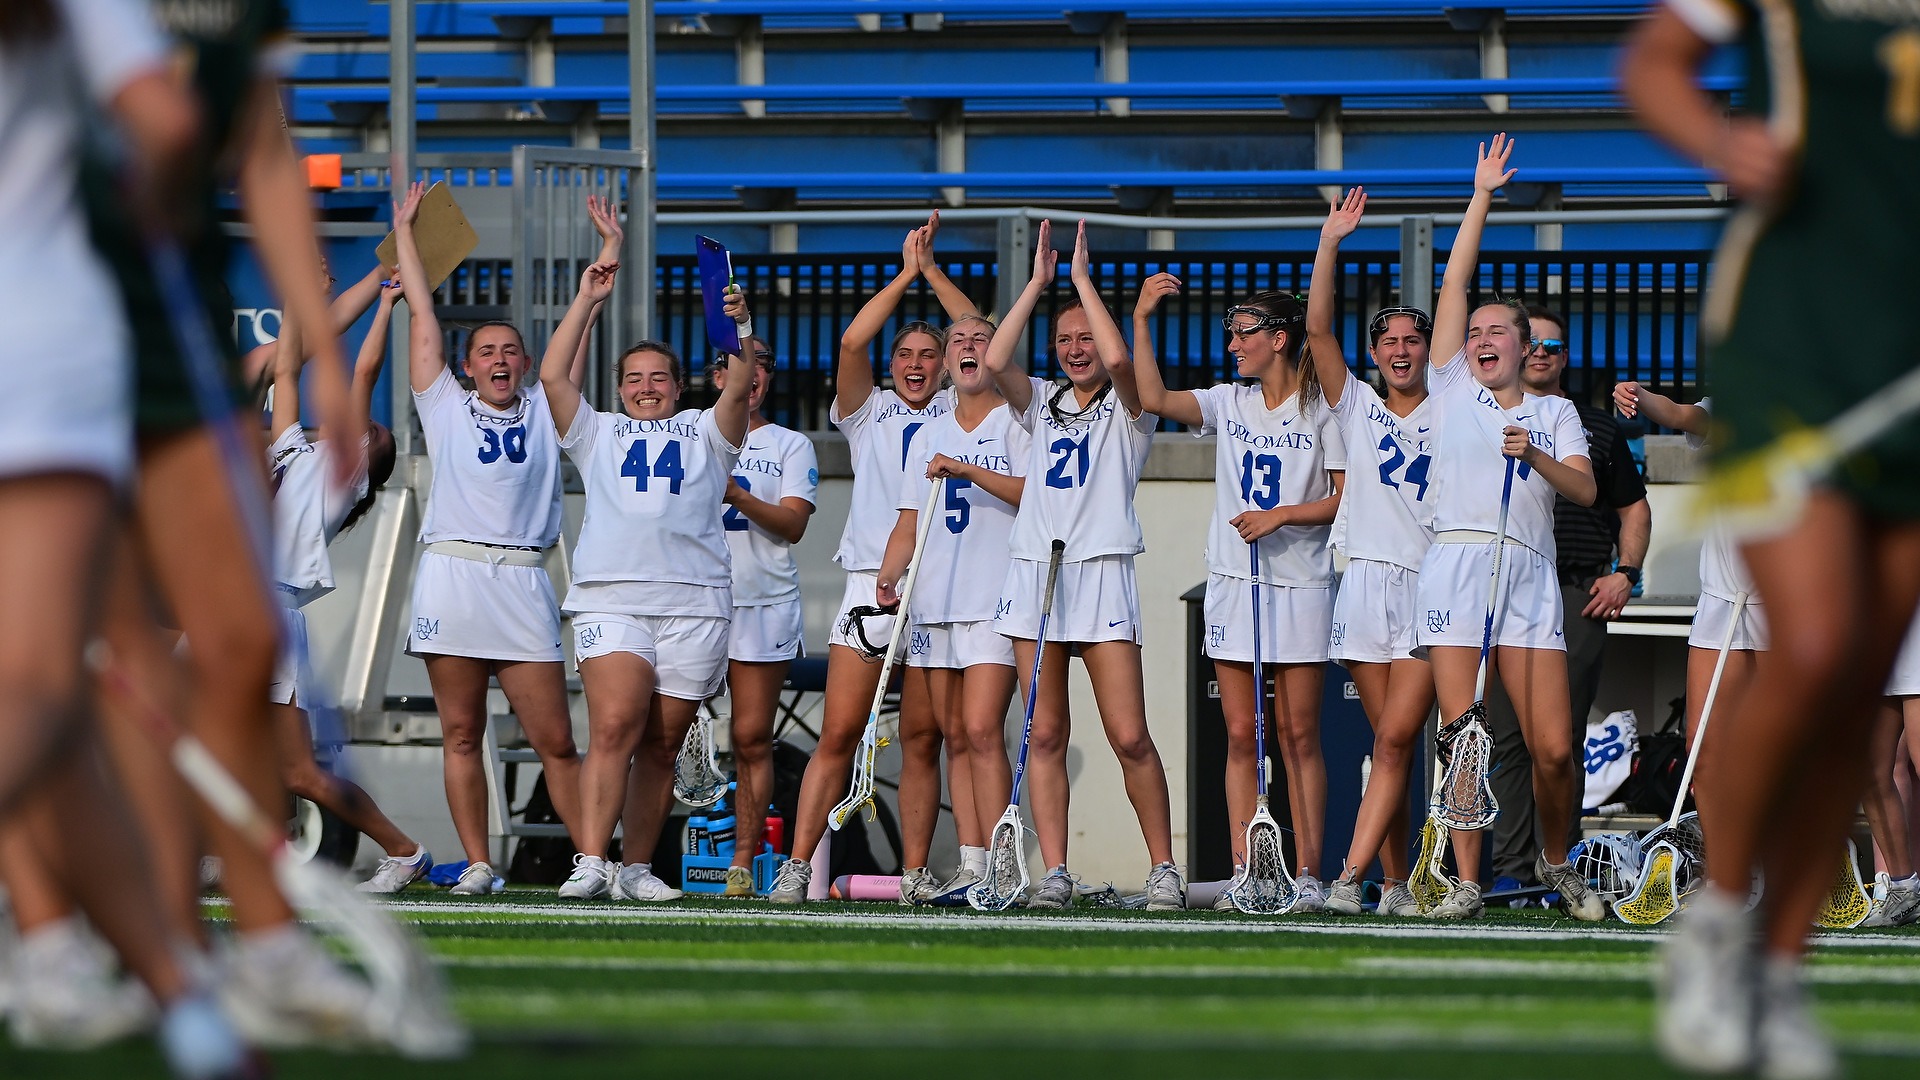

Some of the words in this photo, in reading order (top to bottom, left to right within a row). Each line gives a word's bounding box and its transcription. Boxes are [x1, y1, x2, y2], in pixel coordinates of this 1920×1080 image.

[1268, 317, 1288, 325] STX
[477, 423, 528, 465] 30
[1226, 418, 1313, 451] DIPLOMATS
[620, 438, 685, 496] 44
[1045, 431, 1090, 490] 21
[1240, 449, 1283, 511] 13
[1377, 433, 1433, 503] 24
[945, 476, 973, 535] 5
[415, 616, 441, 642] F&M
[579, 623, 604, 650] F&M
[1427, 609, 1452, 634] F&M
[1452, 710, 1475, 729] STX
[1583, 724, 1626, 775] 28
